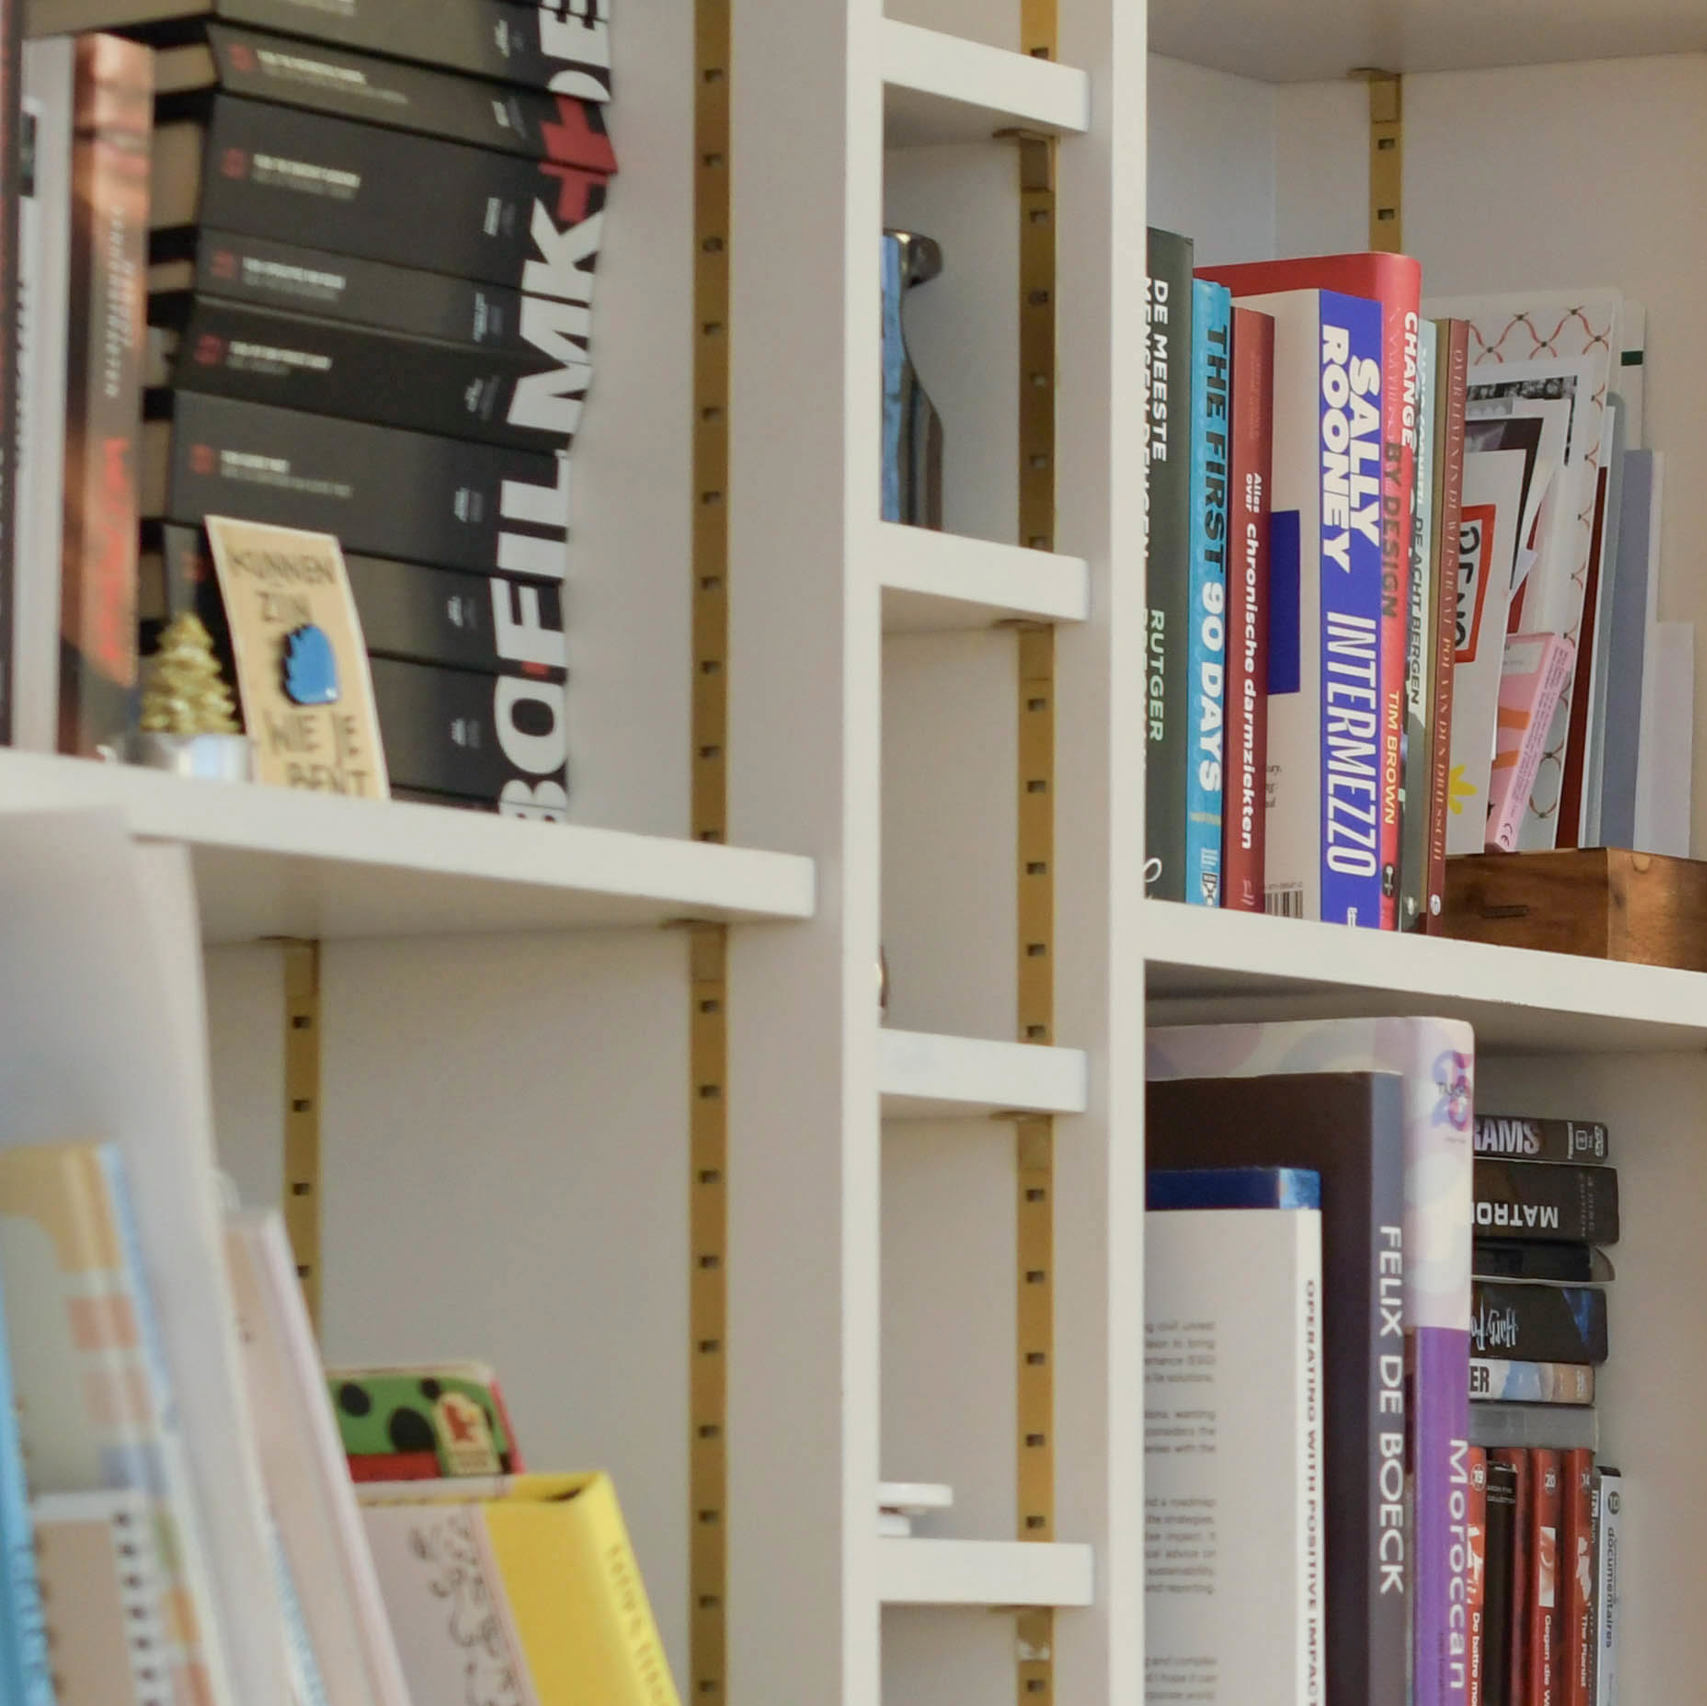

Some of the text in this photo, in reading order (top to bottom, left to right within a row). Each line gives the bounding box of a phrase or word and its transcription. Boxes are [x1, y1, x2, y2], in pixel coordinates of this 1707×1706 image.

[1151, 279, 1168, 462] DE MEESTE
[1402, 312, 1416, 447] CHANGE
[1244, 473, 1253, 512] over
[1253, 472, 1263, 514] Alles
[1320, 324, 1350, 572] ROONEY
[1348, 356, 1381, 548] SALLY
[1199, 325, 1228, 792] THE FIRST 90 DAYS
[1382, 441, 1402, 619] BY DESIGN
[1149, 610, 1165, 741] RUTGER
[1410, 516, 1424, 705] DE ACHT BERGEN
[1240, 522, 1258, 850] chronische darmziekten
[1326, 611, 1378, 879] INTERMEZZO
[1384, 690, 1399, 825] TIM BROWN
[1473, 1201, 1559, 1229] MATRO
[1306, 1280, 1317, 1423] OPERATING
[1485, 1305, 1519, 1348] Harry
[1306, 1430, 1318, 1492] WITH
[1376, 1226, 1404, 1596] FELIX DE BOECK
[1307, 1500, 1318, 1609] POSITIVE
[1447, 1439, 1469, 1689] Moroccan
[1471, 1635, 1480, 1678] battre
[1543, 1615, 1552, 1661] Gegen
